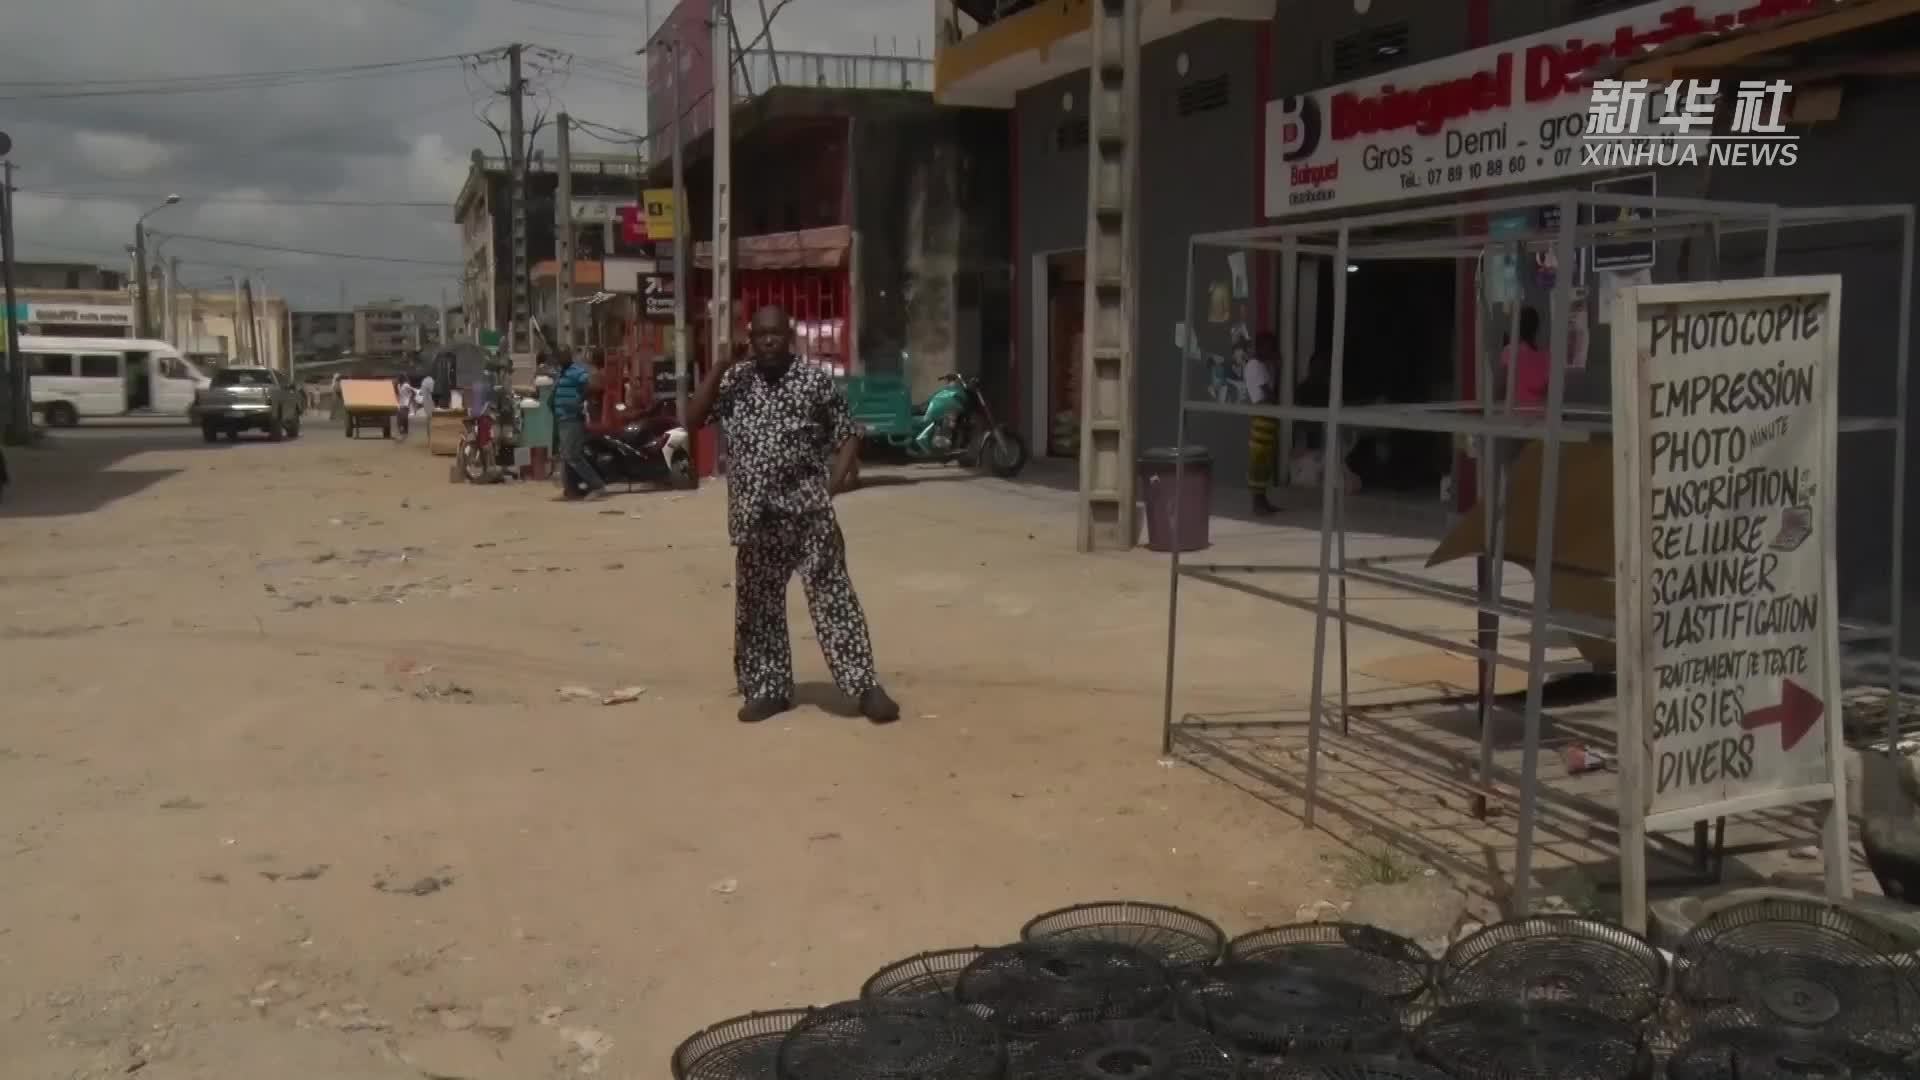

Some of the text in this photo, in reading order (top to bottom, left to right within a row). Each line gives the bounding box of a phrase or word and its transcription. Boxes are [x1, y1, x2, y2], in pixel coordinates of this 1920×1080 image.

[1362, 143, 1413, 171] Gros
[1446, 122, 1507, 159] Demi
[1428, 168, 1442, 186] 07
[1554, 147, 1571, 166] 07
[1650, 302, 1820, 357] PHOTOCOPIE
[1650, 360, 1814, 419] IMPRESSION
[1651, 426, 1746, 475] PHOTO
[1651, 466, 1798, 521] INSCRIPTION
[1651, 513, 1768, 560] RELIURE
[1652, 553, 1778, 604] SCANNER
[1653, 593, 1818, 649] PLASTIFICATION
[1762, 645, 1808, 675] TEXTE
[1652, 682, 1744, 740] SAISIES
[1657, 733, 1755, 794] DIVERS
